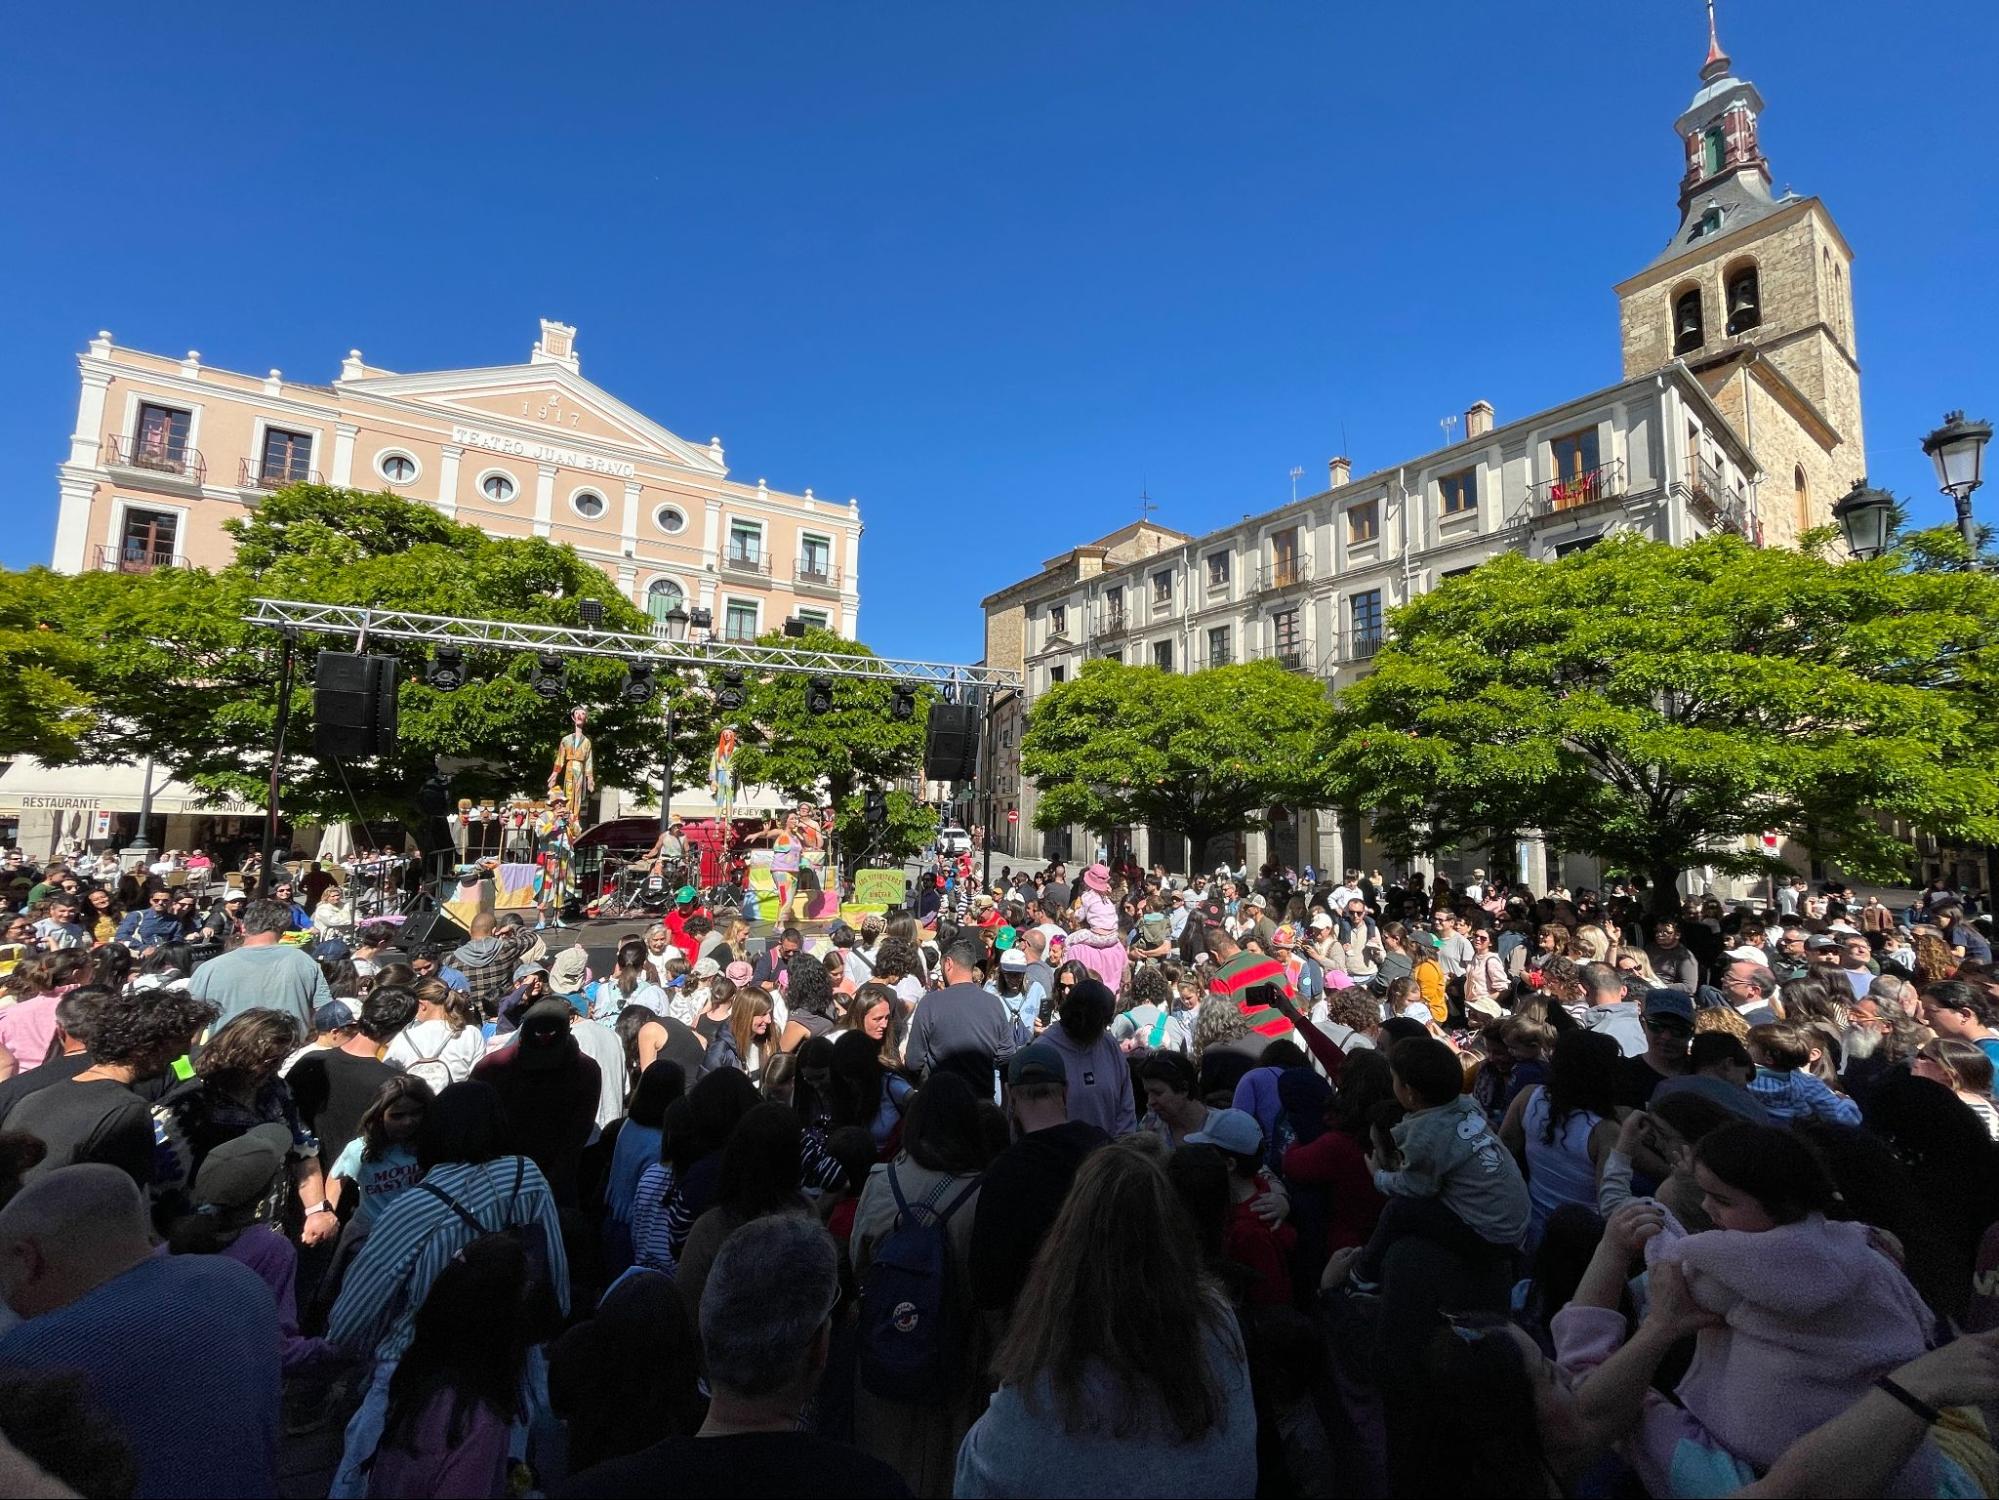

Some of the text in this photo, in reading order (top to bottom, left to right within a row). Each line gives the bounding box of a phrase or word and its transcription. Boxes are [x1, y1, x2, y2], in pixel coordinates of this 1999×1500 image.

[522, 401, 580, 427] 1917
[456, 428, 634, 478] TEATRO JUAN BRAVO
[22, 797, 101, 809] RESTAURANTE
